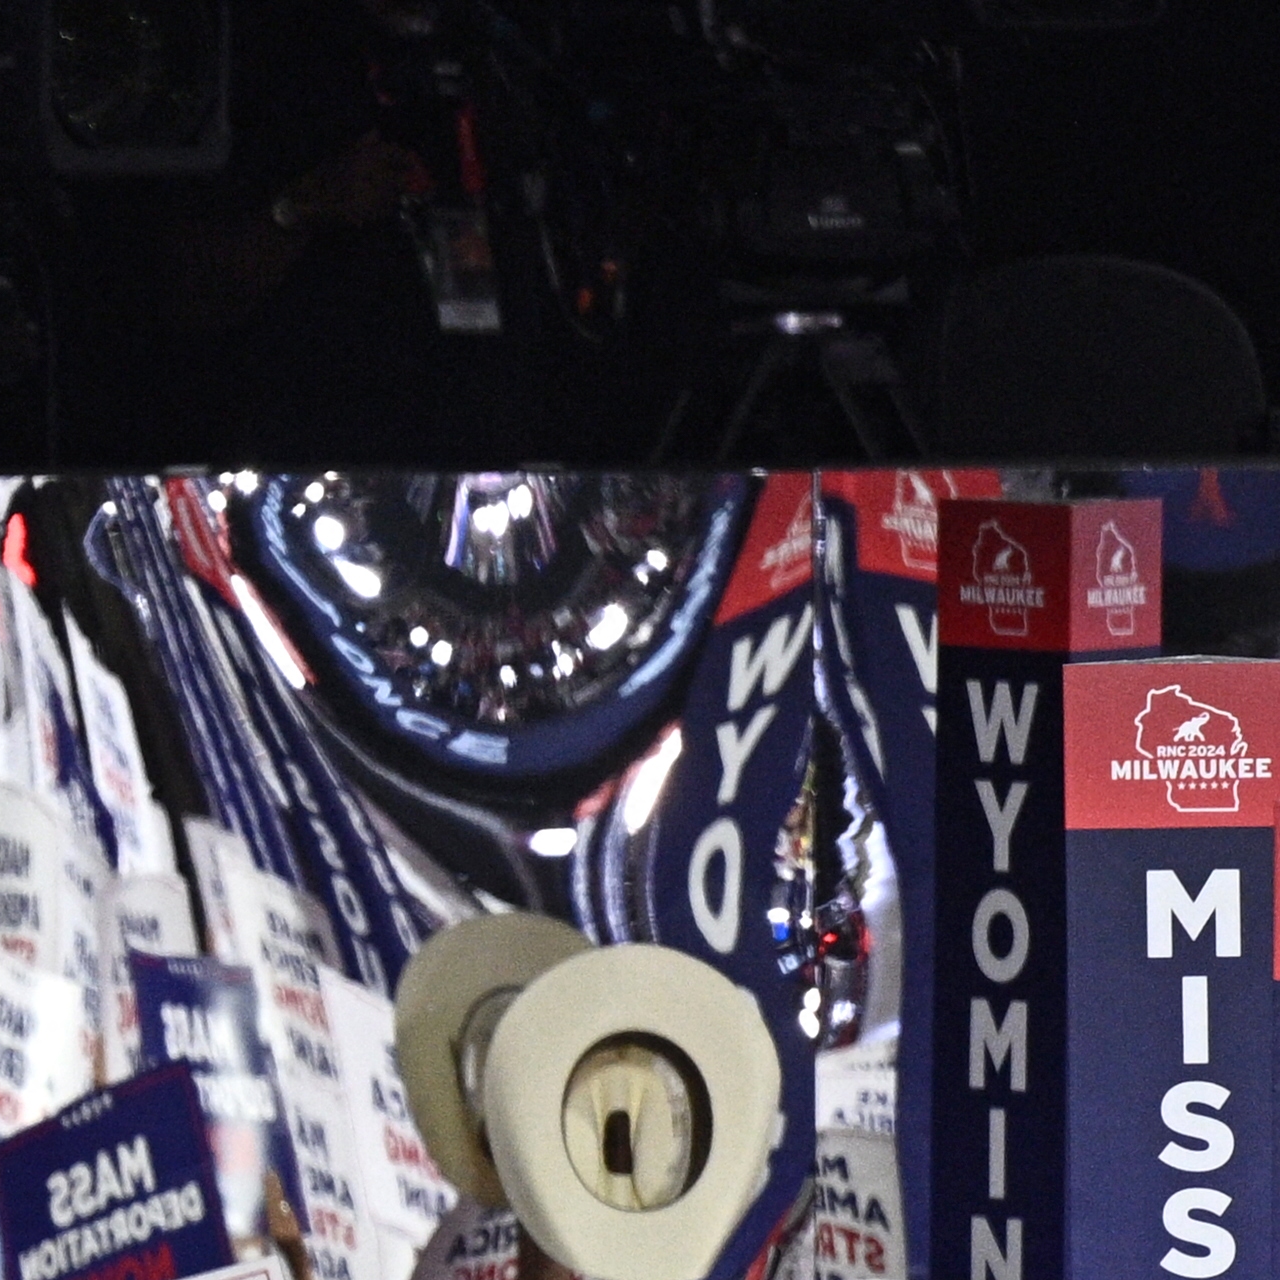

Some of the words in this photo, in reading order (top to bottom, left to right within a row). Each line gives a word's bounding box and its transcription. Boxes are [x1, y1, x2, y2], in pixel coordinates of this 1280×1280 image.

[960, 585, 1044, 608] MILWAUKEE
[1157, 745, 1186, 757] RNC
[1188, 745, 1225, 757] 2024
[1111, 758, 1272, 780] MILWAUKEE
